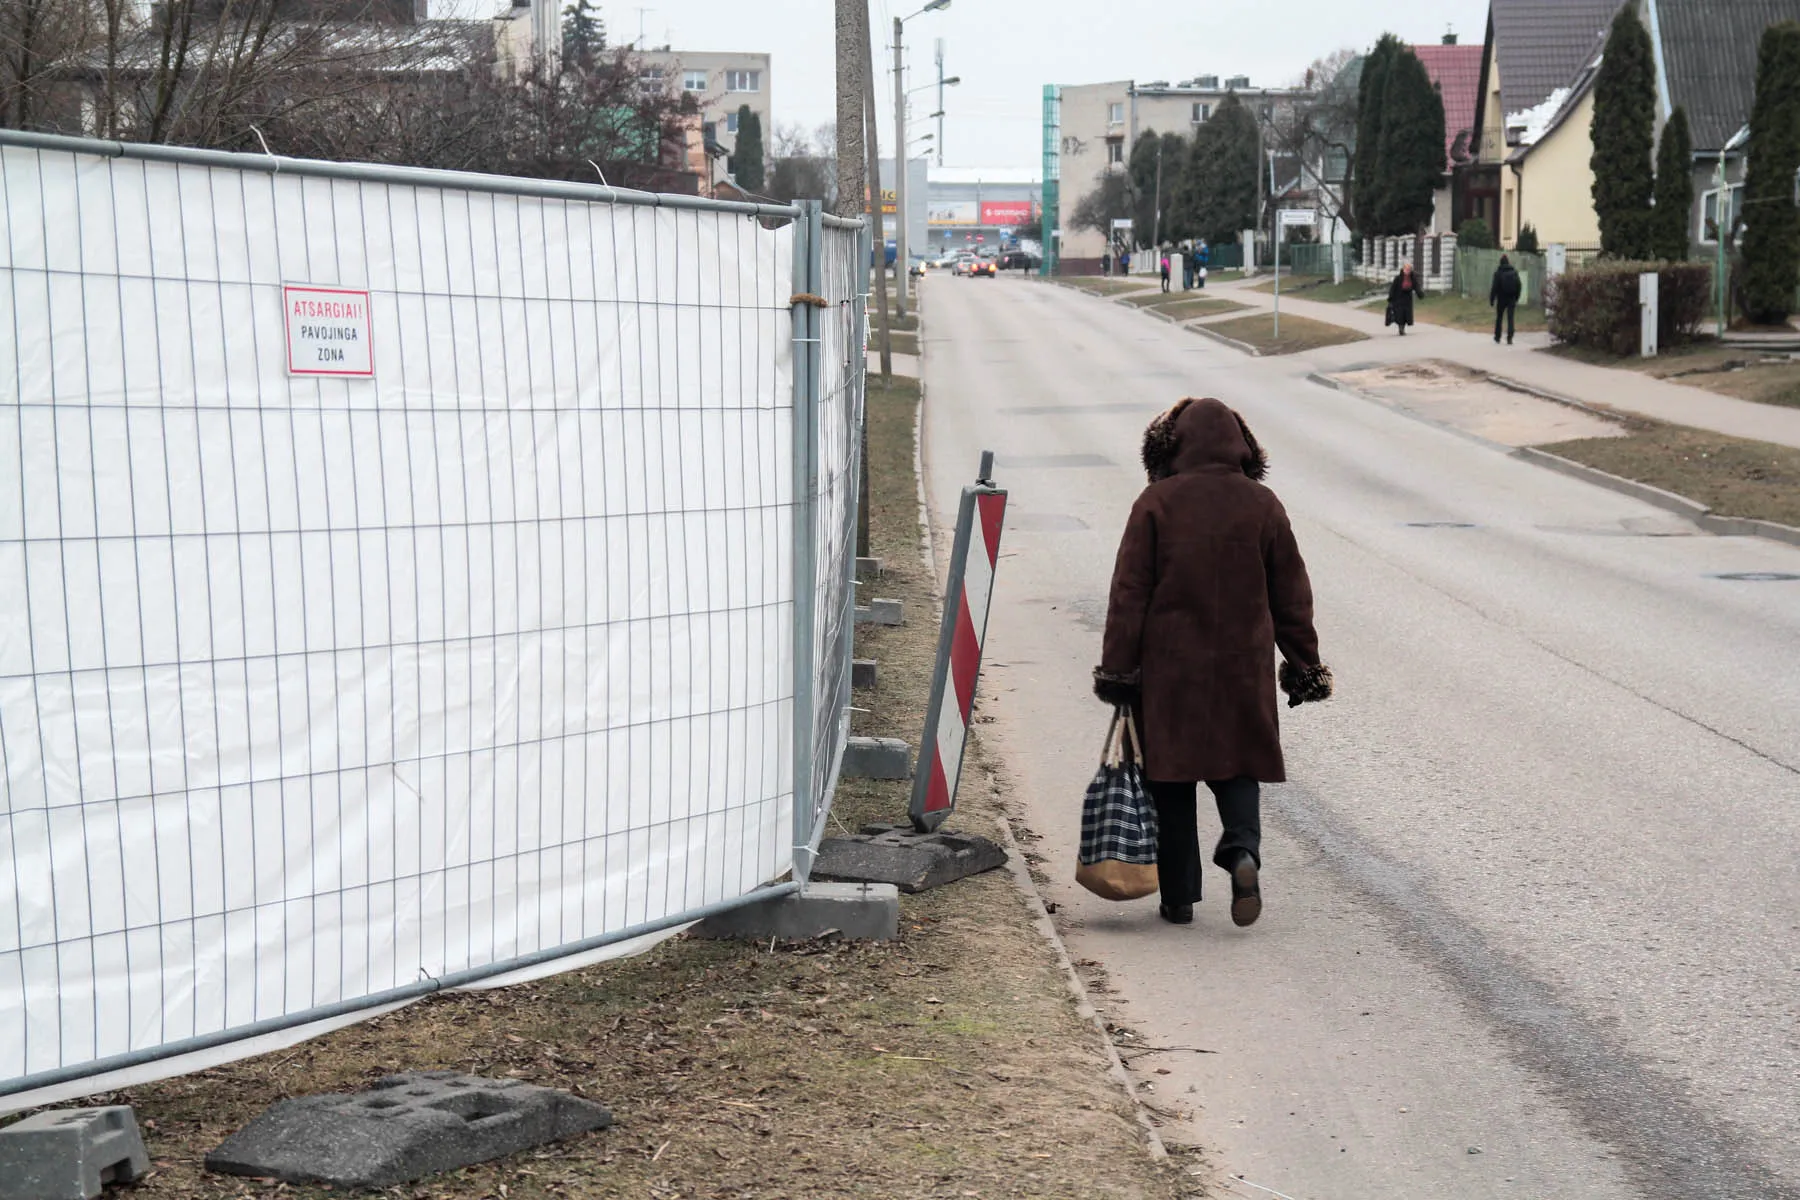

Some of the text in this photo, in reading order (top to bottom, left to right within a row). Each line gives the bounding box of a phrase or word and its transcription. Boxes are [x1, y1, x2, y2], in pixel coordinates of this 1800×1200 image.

[294, 300, 362, 319] ATSARGIAI!
[301, 325, 358, 341] PAVOJINGA
[317, 347, 345, 361] ZONA
